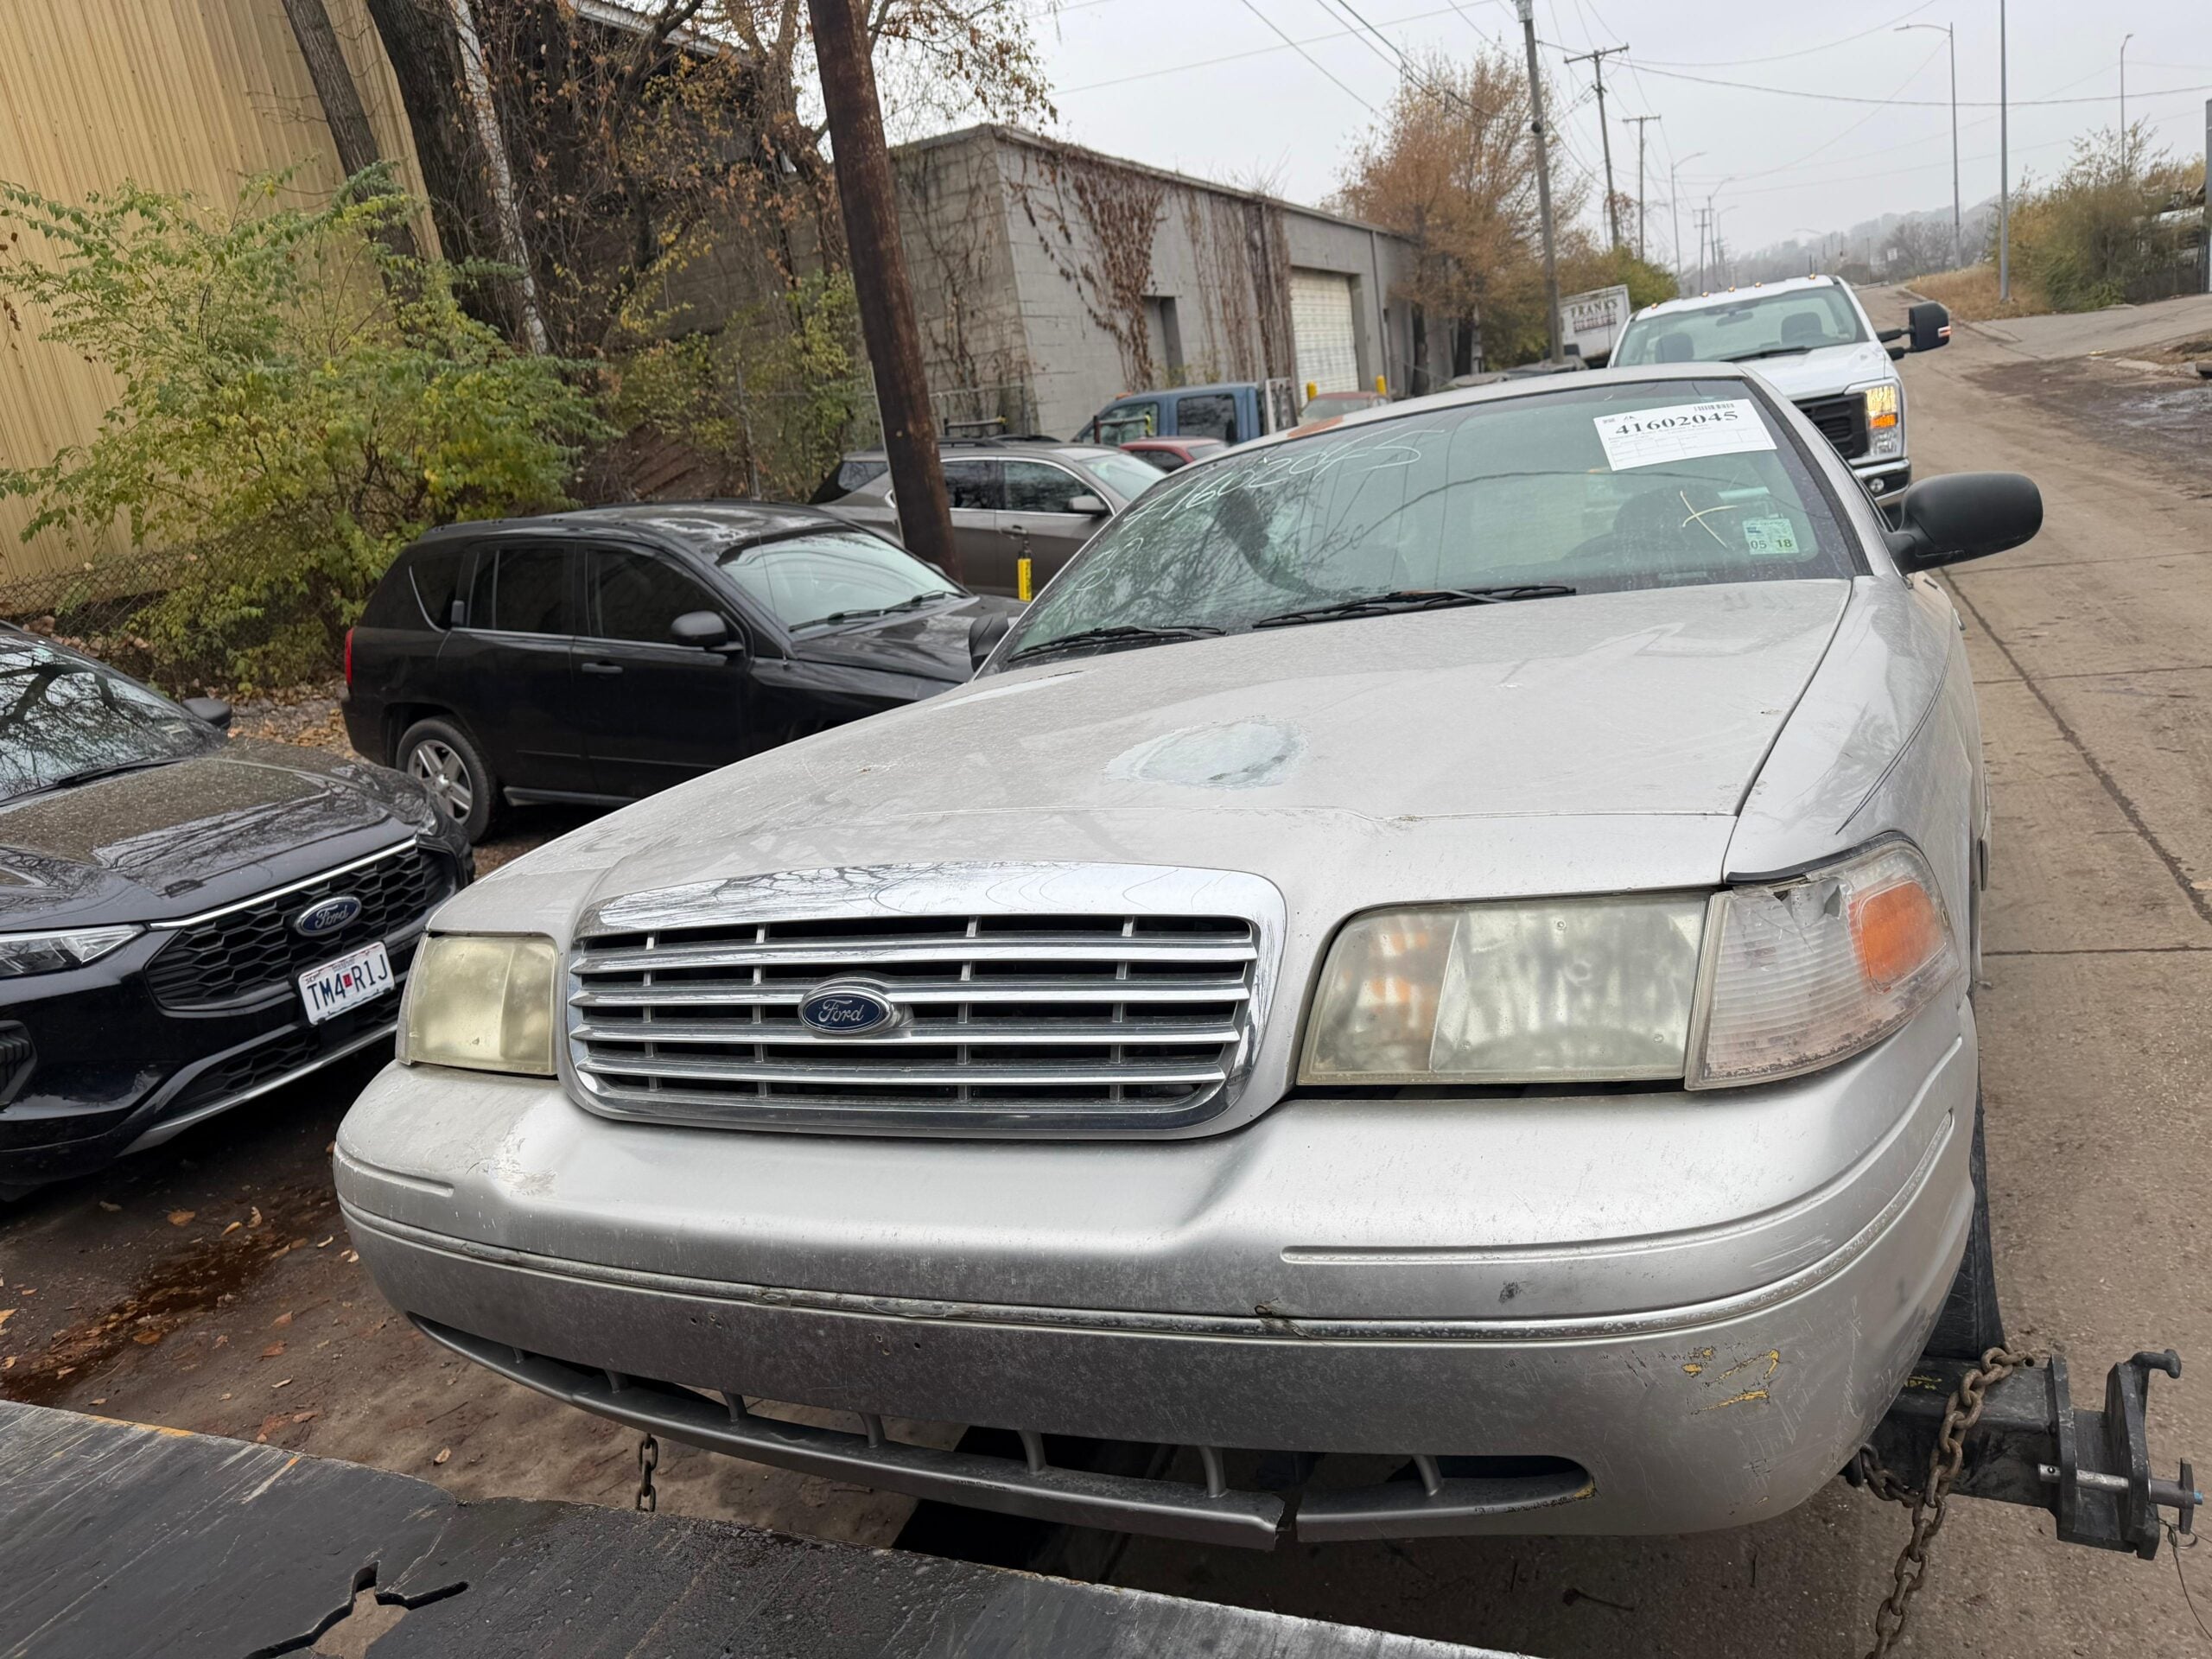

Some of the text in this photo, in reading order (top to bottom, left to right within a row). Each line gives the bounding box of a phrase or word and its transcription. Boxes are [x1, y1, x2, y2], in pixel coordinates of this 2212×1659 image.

[1615, 410, 1739, 435] 41602045
[1750, 539, 1793, 550] 05 18
[315, 904, 350, 929] Ford
[817, 999, 865, 1023] Ford
